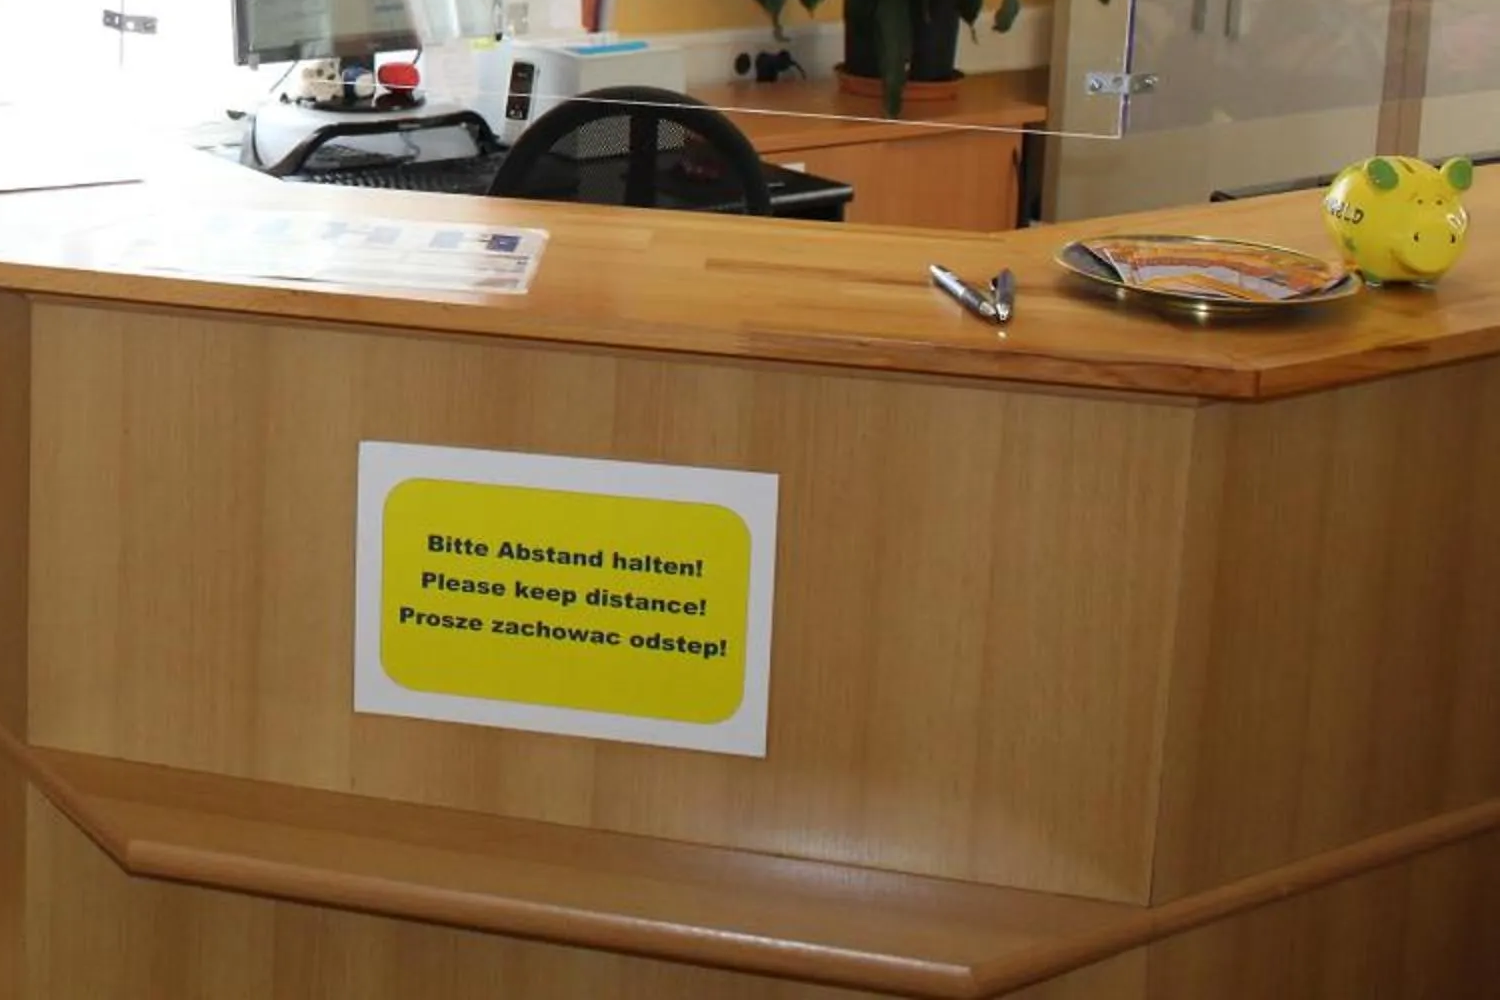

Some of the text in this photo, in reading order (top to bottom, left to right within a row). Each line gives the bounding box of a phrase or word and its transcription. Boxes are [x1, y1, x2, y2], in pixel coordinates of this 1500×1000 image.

[428, 535, 703, 578] Bitte Abstand halten!
[421, 572, 707, 616] Please keep distance!
[400, 607, 727, 660] Prosze zachowac odstep!
